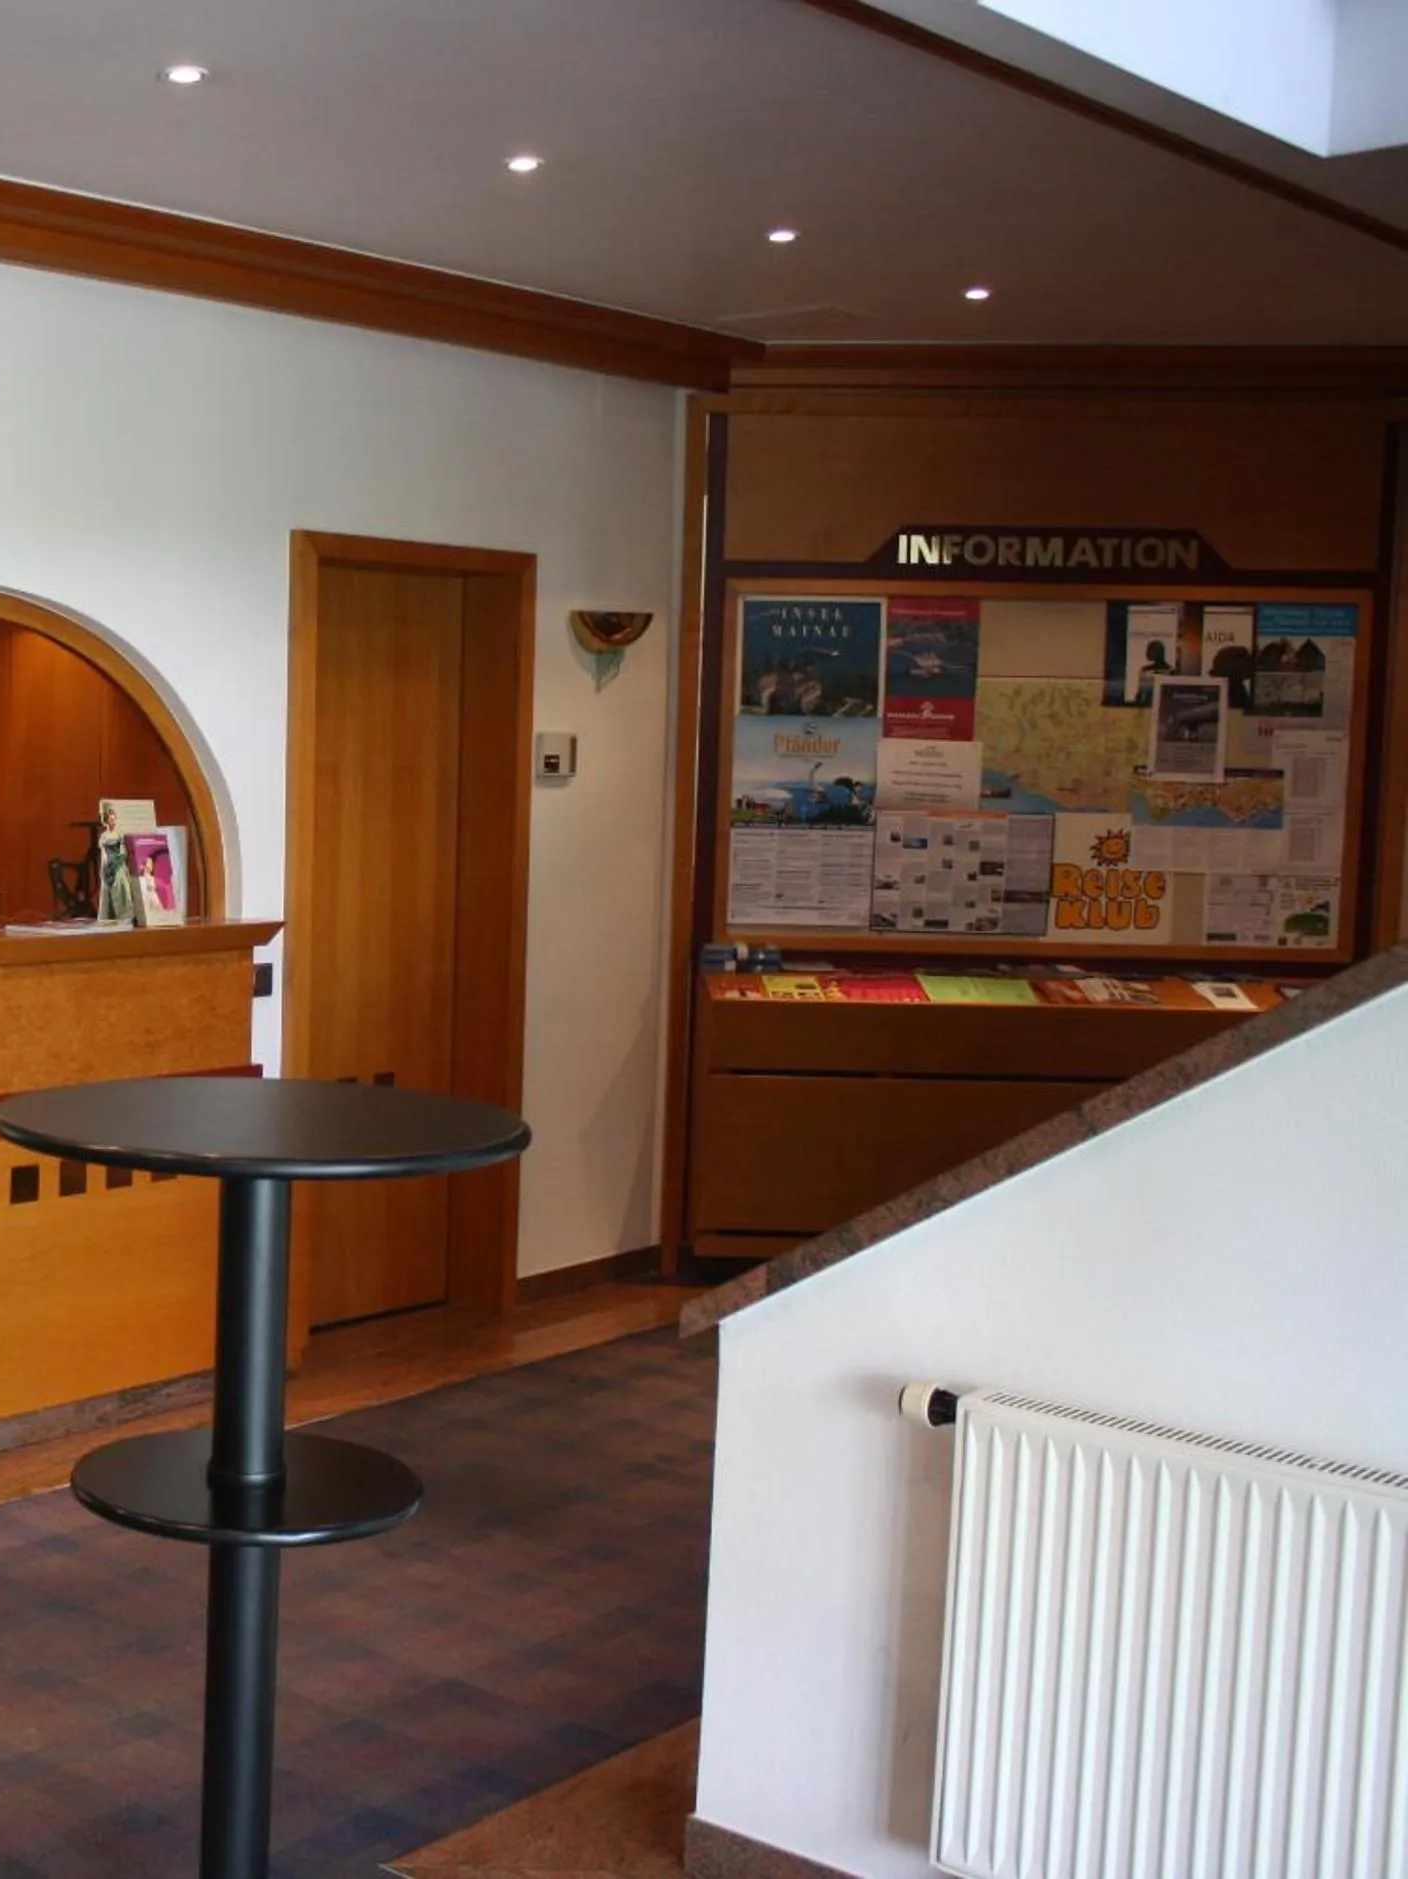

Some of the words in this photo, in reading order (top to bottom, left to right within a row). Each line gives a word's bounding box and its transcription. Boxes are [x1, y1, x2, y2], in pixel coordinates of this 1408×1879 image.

[896, 533, 1199, 570] INFORMATION
[781, 606, 845, 621] INSEL
[772, 623, 852, 638] MAINAU
[1204, 629, 1236, 644] AIDA
[774, 733, 841, 755] Pfänder
